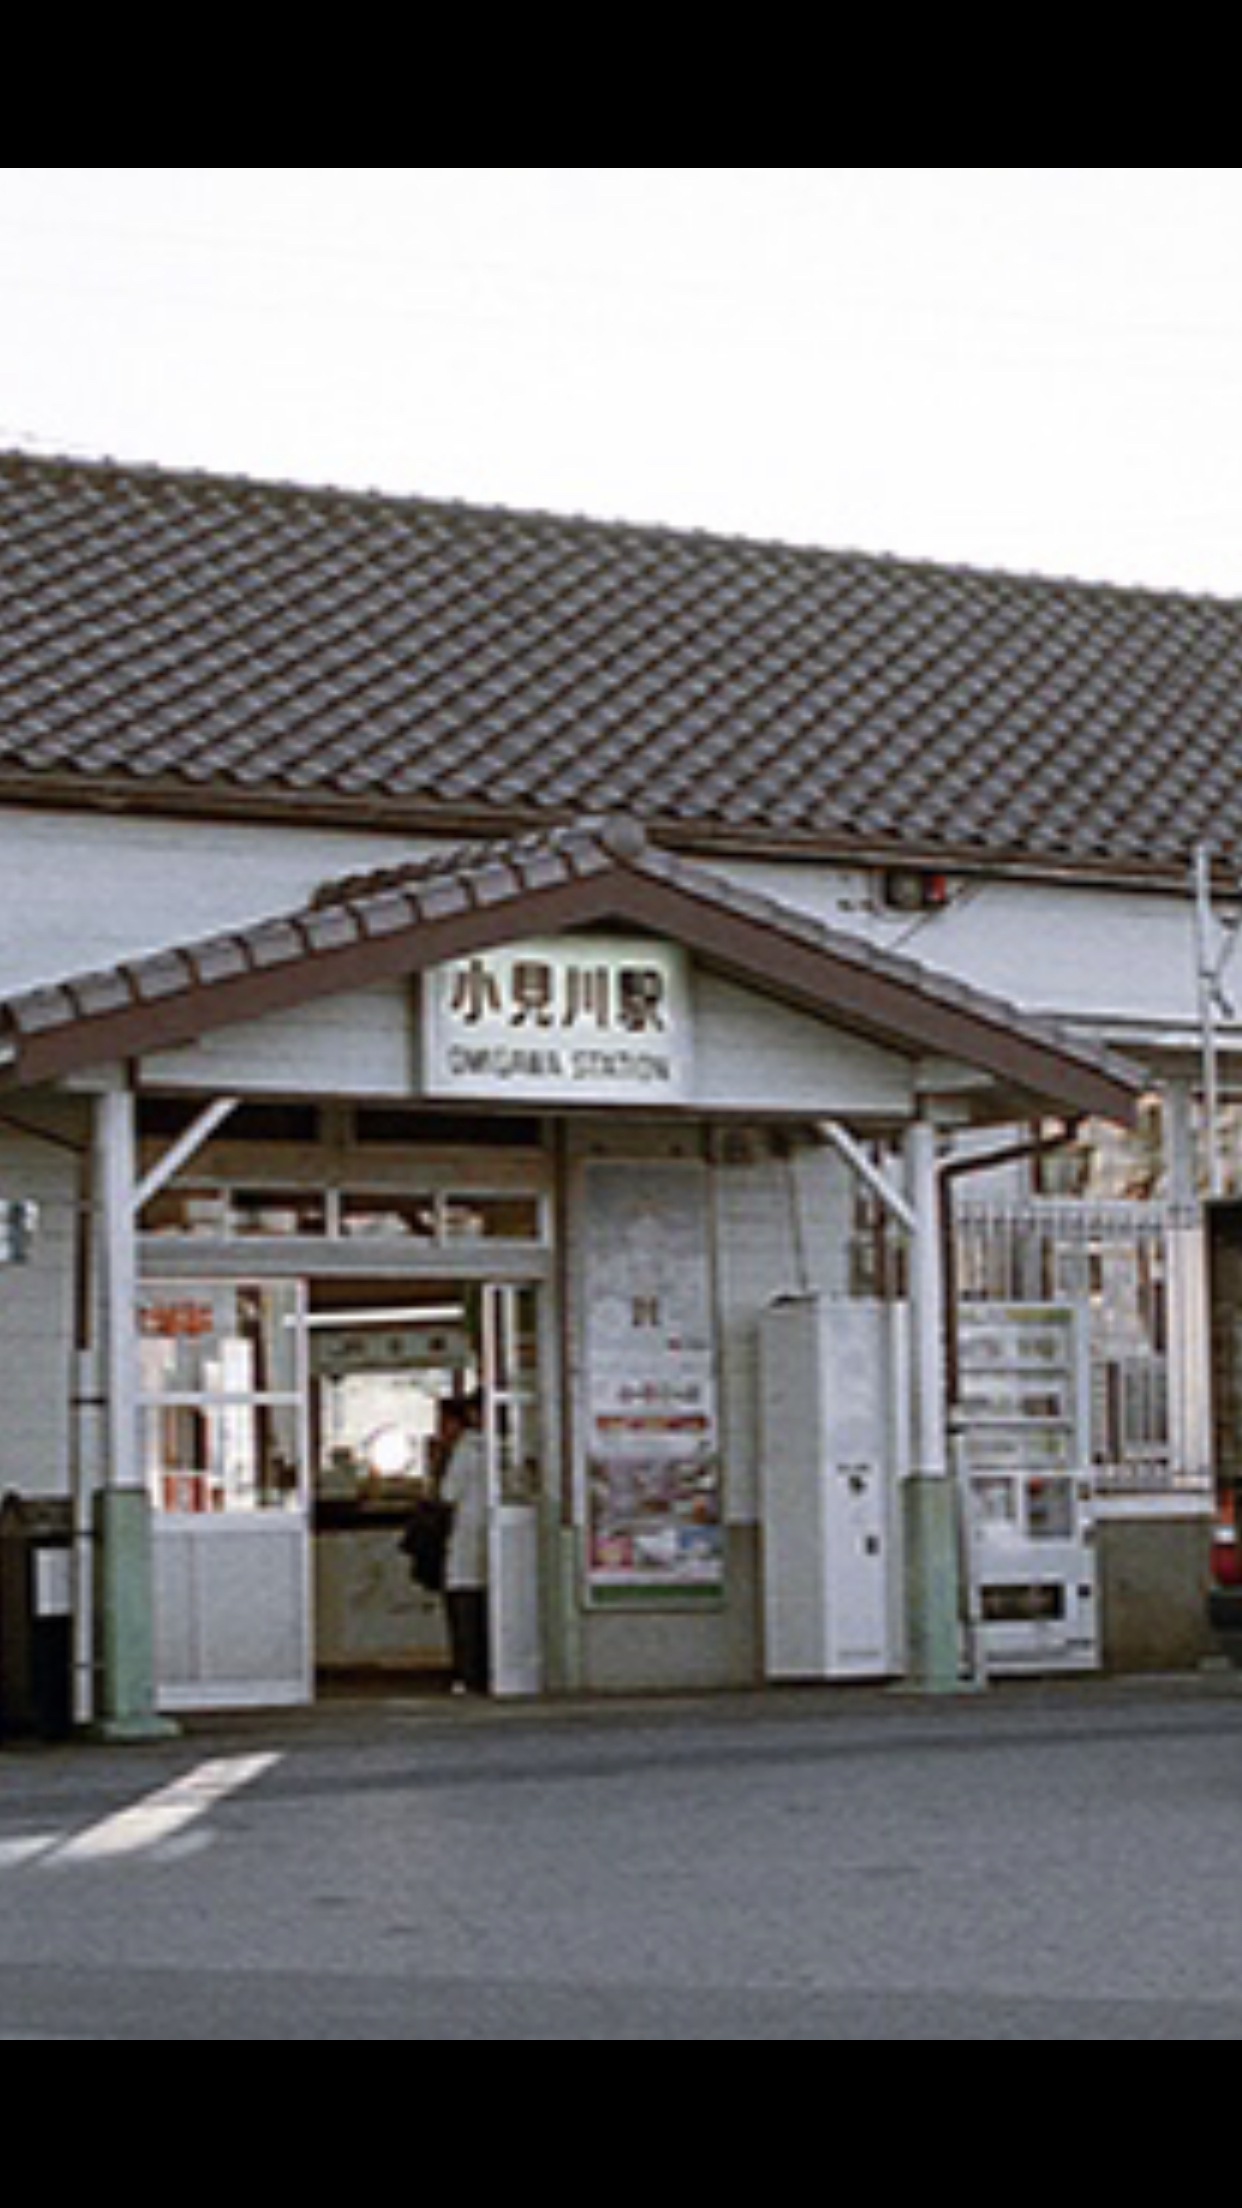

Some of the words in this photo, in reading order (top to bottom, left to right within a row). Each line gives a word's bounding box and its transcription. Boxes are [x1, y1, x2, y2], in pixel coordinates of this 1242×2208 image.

[449, 957, 667, 1033] 小見川駅
[449, 1044, 562, 1080] OMIGAWA
[571, 1048, 670, 1083] STATION
